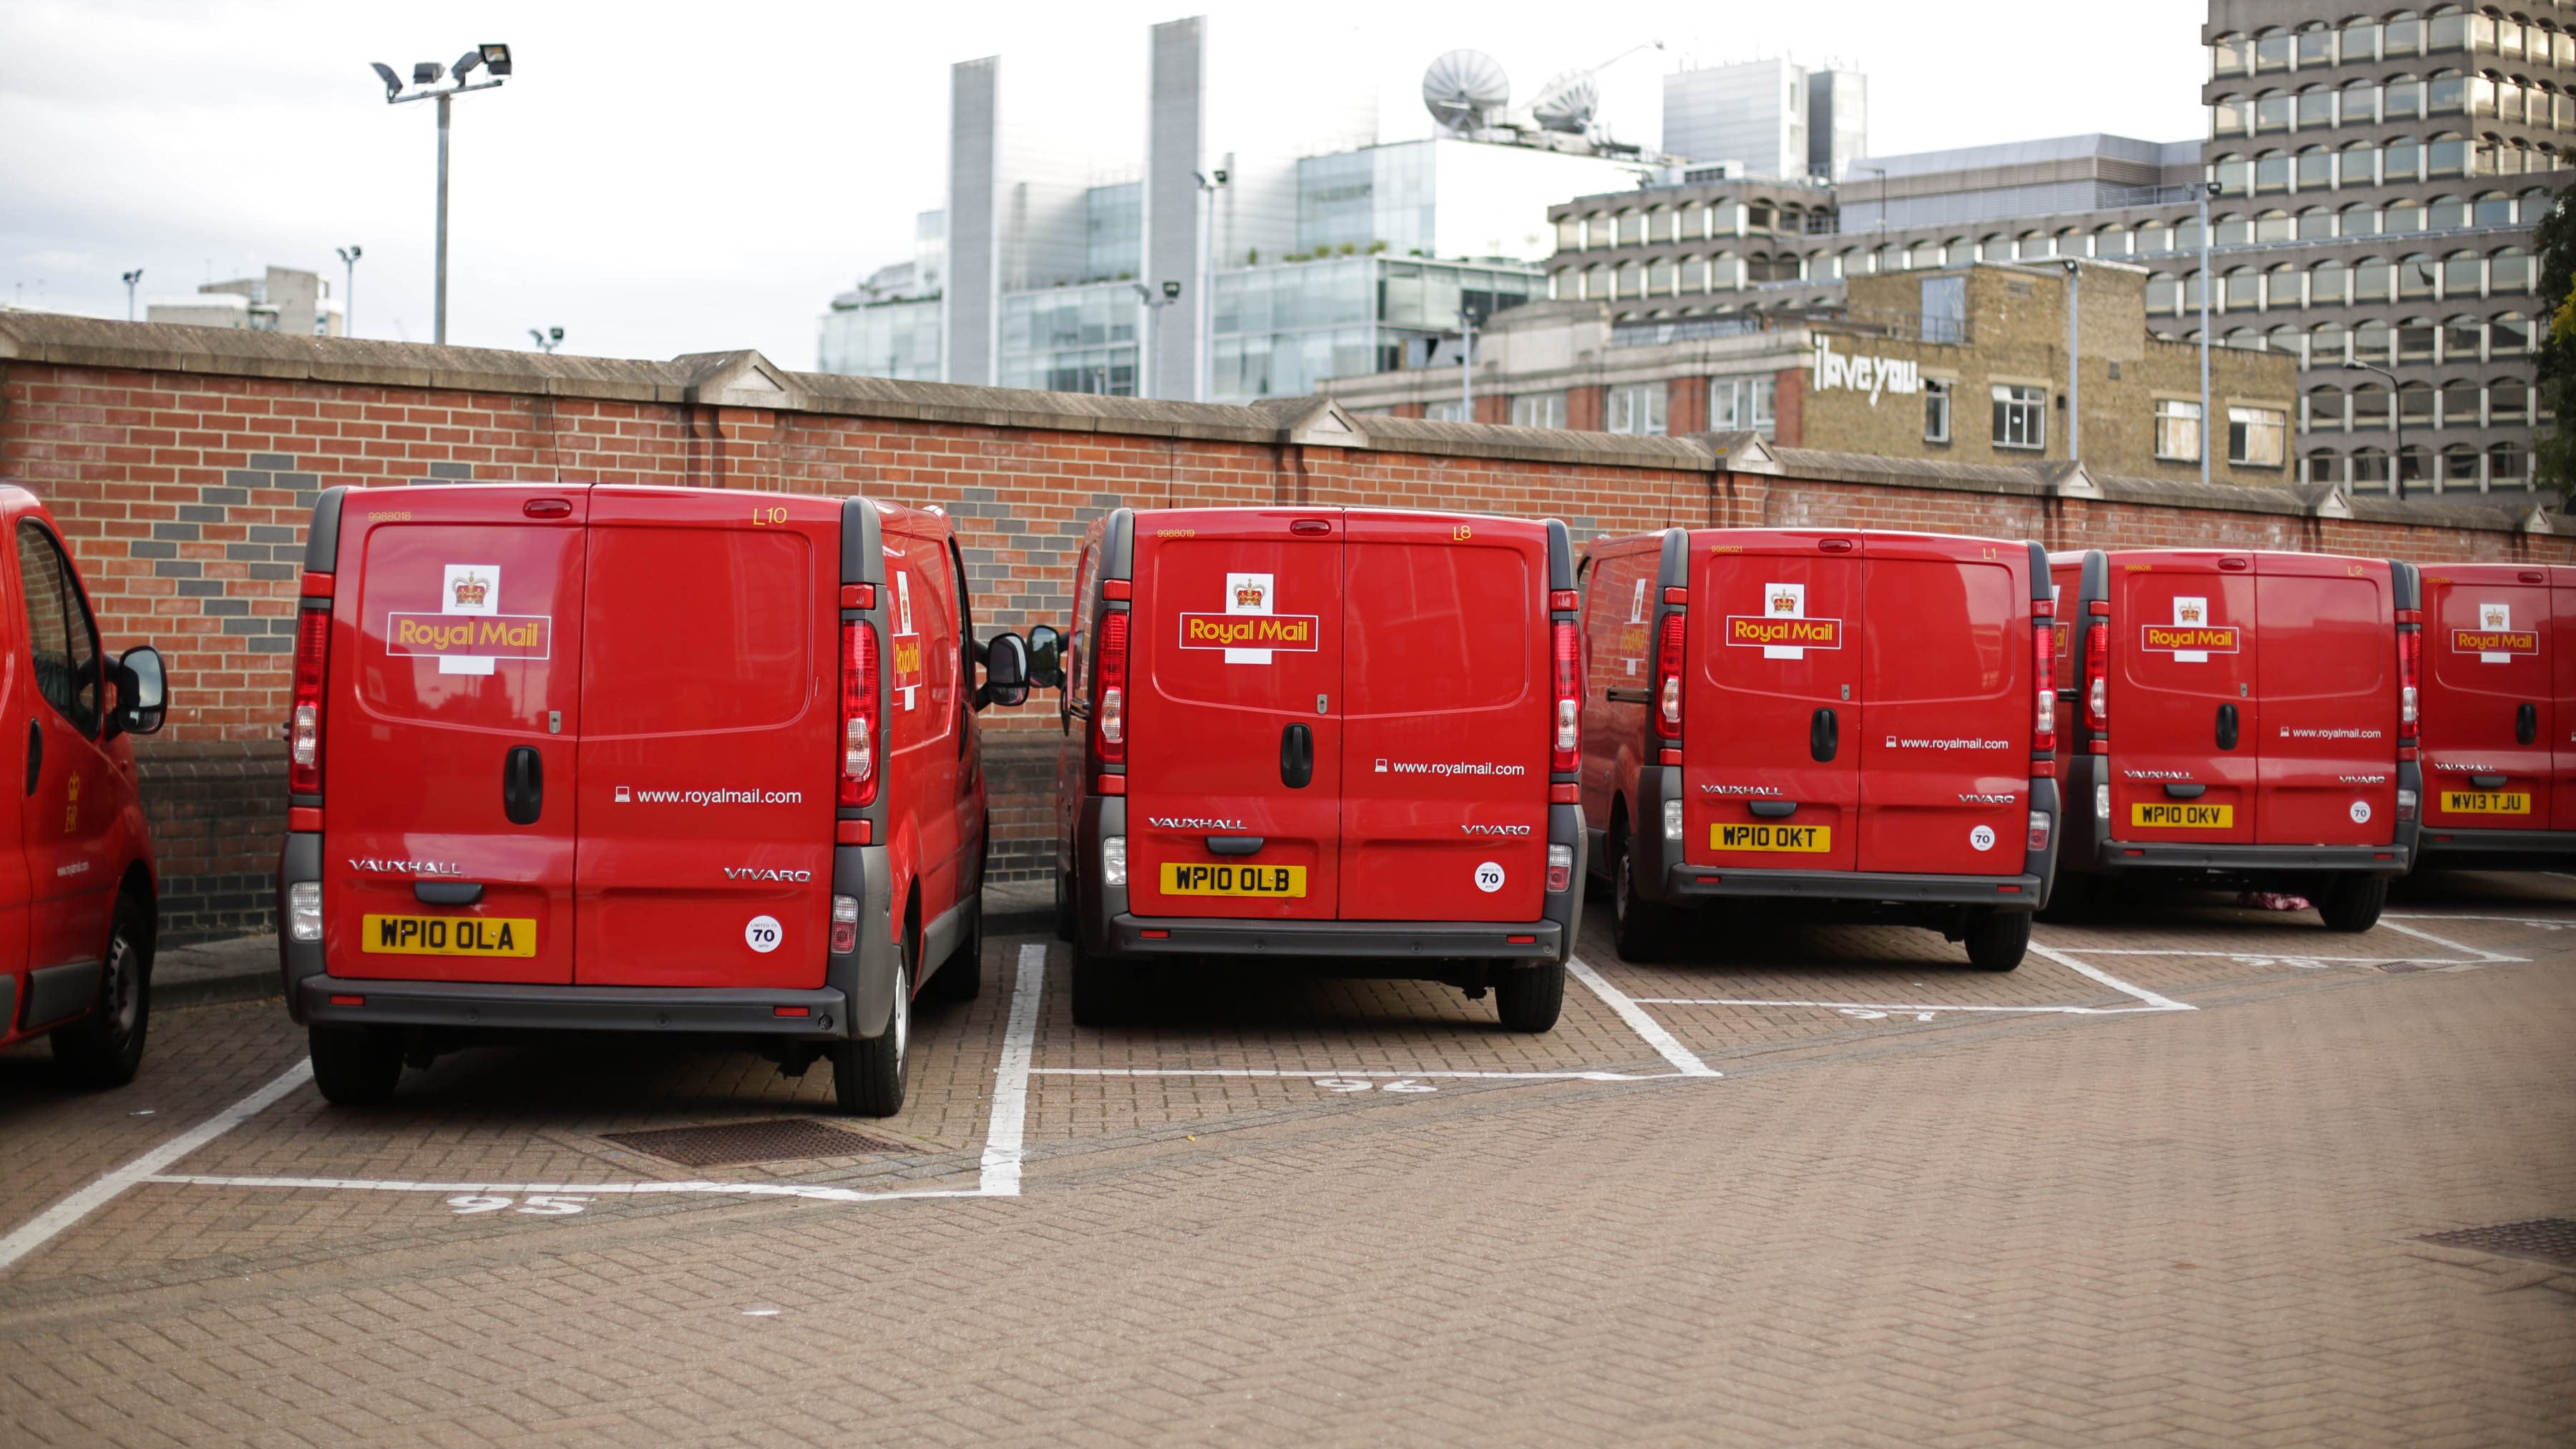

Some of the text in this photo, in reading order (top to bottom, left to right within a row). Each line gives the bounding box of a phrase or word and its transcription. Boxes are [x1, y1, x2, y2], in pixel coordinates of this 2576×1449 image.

[753, 507, 788, 526] L10
[1453, 525, 1472, 541] L8
[1983, 547, 1997, 560] L1
[399, 620, 538, 650] Royal Mail
[1190, 619, 1308, 644] Royal Mail
[1735, 620, 1833, 643] Royal Mail
[2149, 629, 2232, 648] Royal Mail
[2458, 633, 2532, 648] Royal Mail
[896, 642, 910, 680] Royal
[2293, 727, 2381, 739] www.royalmail.com
[1901, 738, 2009, 750] www.royalmail.com
[1393, 761, 1525, 776] www.royalmail.com
[2124, 769, 2194, 780] VAUXHALL
[2435, 762, 2496, 772] VAUXHALL
[2339, 775, 2386, 784] VIVARO
[637, 788, 802, 806] www.royalmail.com
[1701, 784, 1783, 796] VAUXHALL
[1958, 794, 2016, 804] VIVARO
[2451, 792, 2522, 811] WV13 TJU
[2142, 806, 2220, 824] WP10 OKV
[1148, 817, 1247, 829] VAUXHALL
[1461, 825, 1531, 835] VIVARO
[1723, 826, 1817, 847] WP10 OKT
[1975, 834, 1990, 844] 70
[348, 859, 463, 875] VAUXHALL
[724, 867, 811, 882] VIVARO
[1176, 867, 1289, 891] WP10 OLB
[1481, 873, 1498, 884] 70
[381, 919, 514, 950] WP10 OLA
[753, 929, 775, 942] 70
[1314, 1079, 1438, 1093] 96
[447, 1196, 596, 1214] 95
